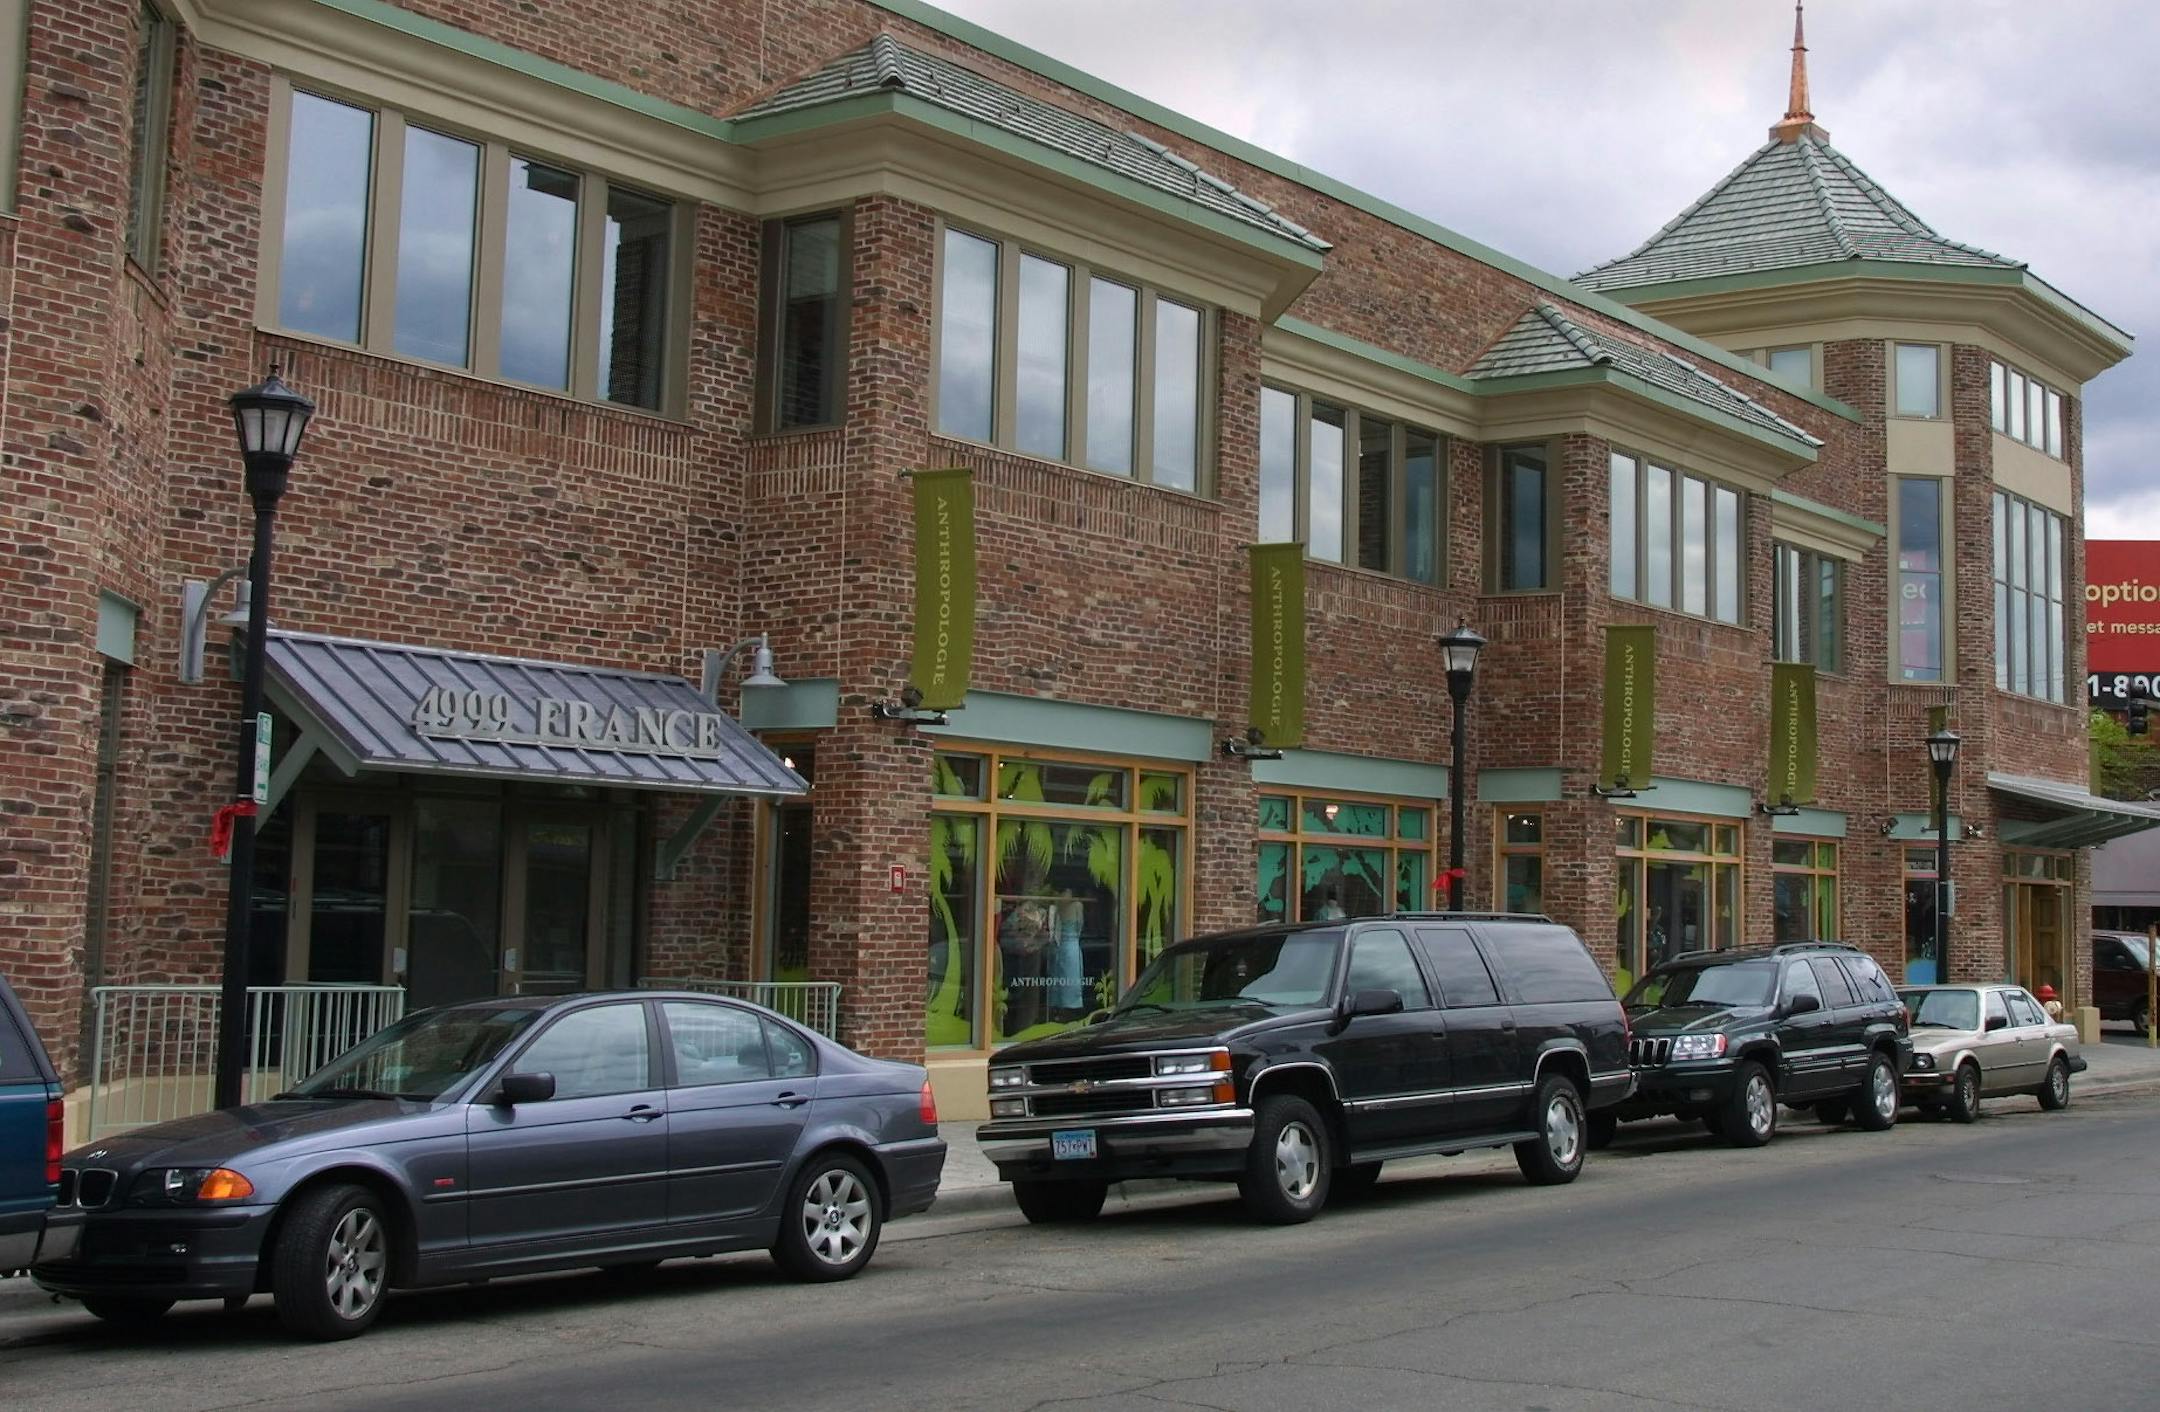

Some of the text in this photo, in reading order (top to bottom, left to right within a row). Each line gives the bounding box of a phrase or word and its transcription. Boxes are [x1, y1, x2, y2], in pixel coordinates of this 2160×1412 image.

[933, 496, 951, 686] ANTHROPOLOGIE
[2085, 579, 2160, 608] optio
[1270, 566, 1283, 727] ANTHROPOLOGIE
[413, 685, 723, 755] 4999 FRANCE
[1621, 644, 1634, 775] ANTHROPOLOGIE
[1010, 977, 1095, 987] ANTHROPOLGIE
